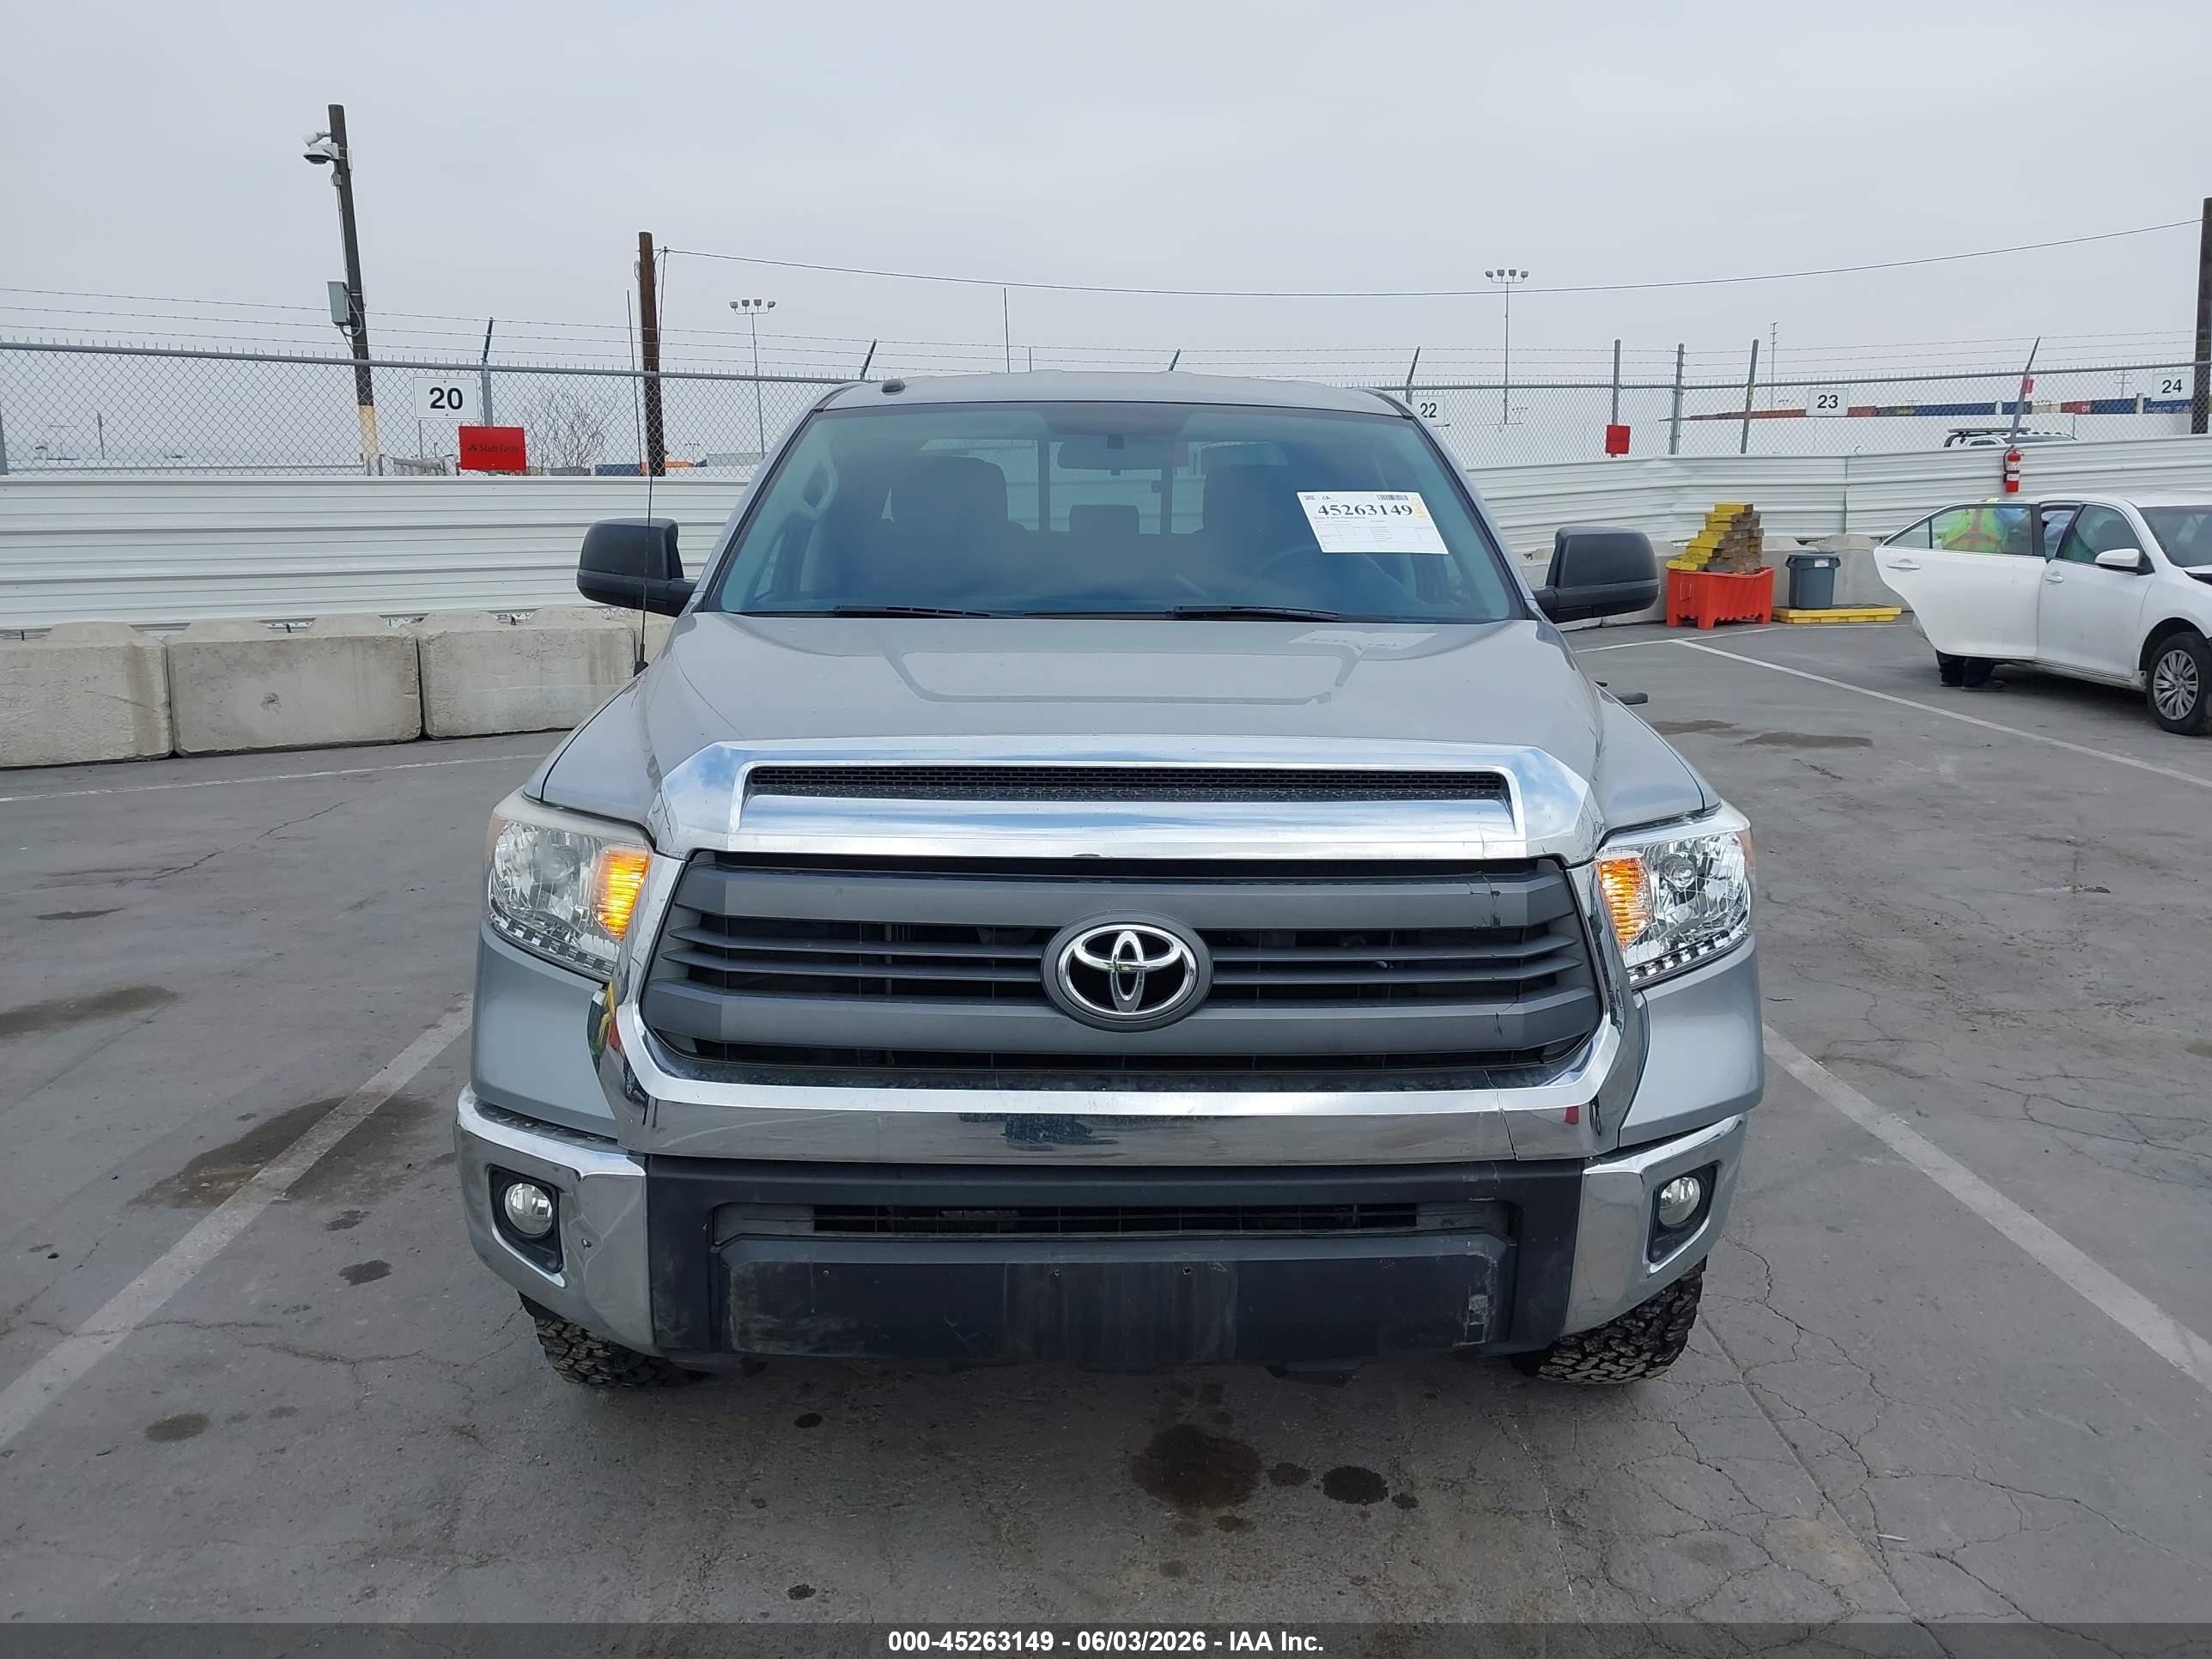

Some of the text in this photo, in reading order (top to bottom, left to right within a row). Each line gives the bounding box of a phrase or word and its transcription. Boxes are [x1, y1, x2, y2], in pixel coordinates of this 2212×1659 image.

[2161, 379, 2183, 394] 24
[428, 386, 464, 410] 20
[1817, 394, 1839, 410] 23
[1419, 402, 1437, 418] 22
[1317, 504, 1413, 516] 45263149
